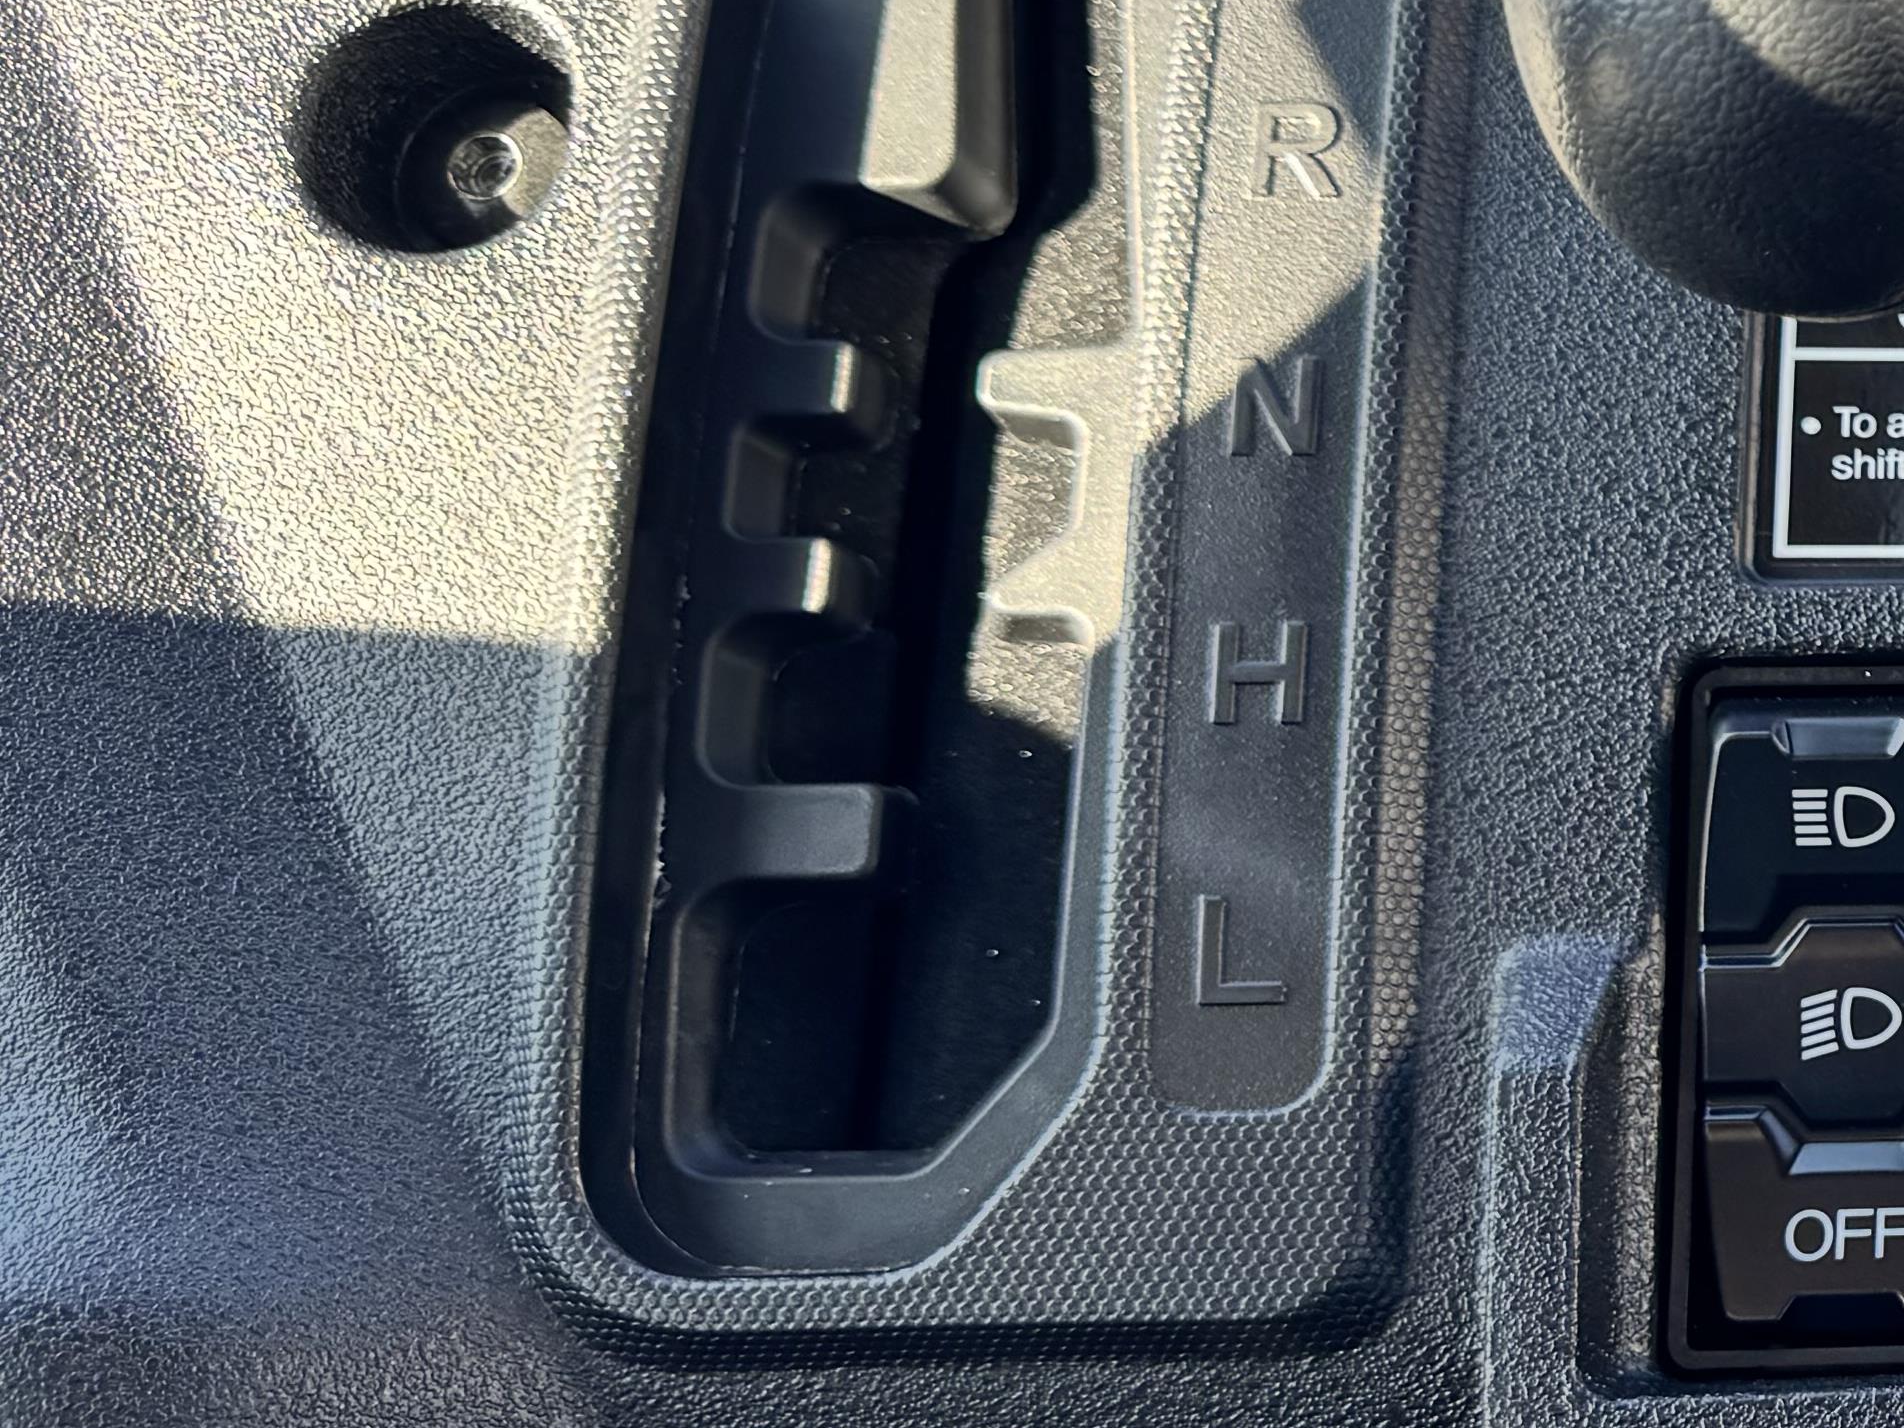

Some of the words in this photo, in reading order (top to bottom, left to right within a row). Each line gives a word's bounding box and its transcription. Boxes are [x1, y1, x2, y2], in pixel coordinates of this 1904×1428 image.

[1248, 99, 1343, 198] R
[1230, 355, 1325, 456] N
[1832, 405, 1878, 439] To
[1209, 621, 1308, 724] H
[1198, 894, 1287, 1005] L
